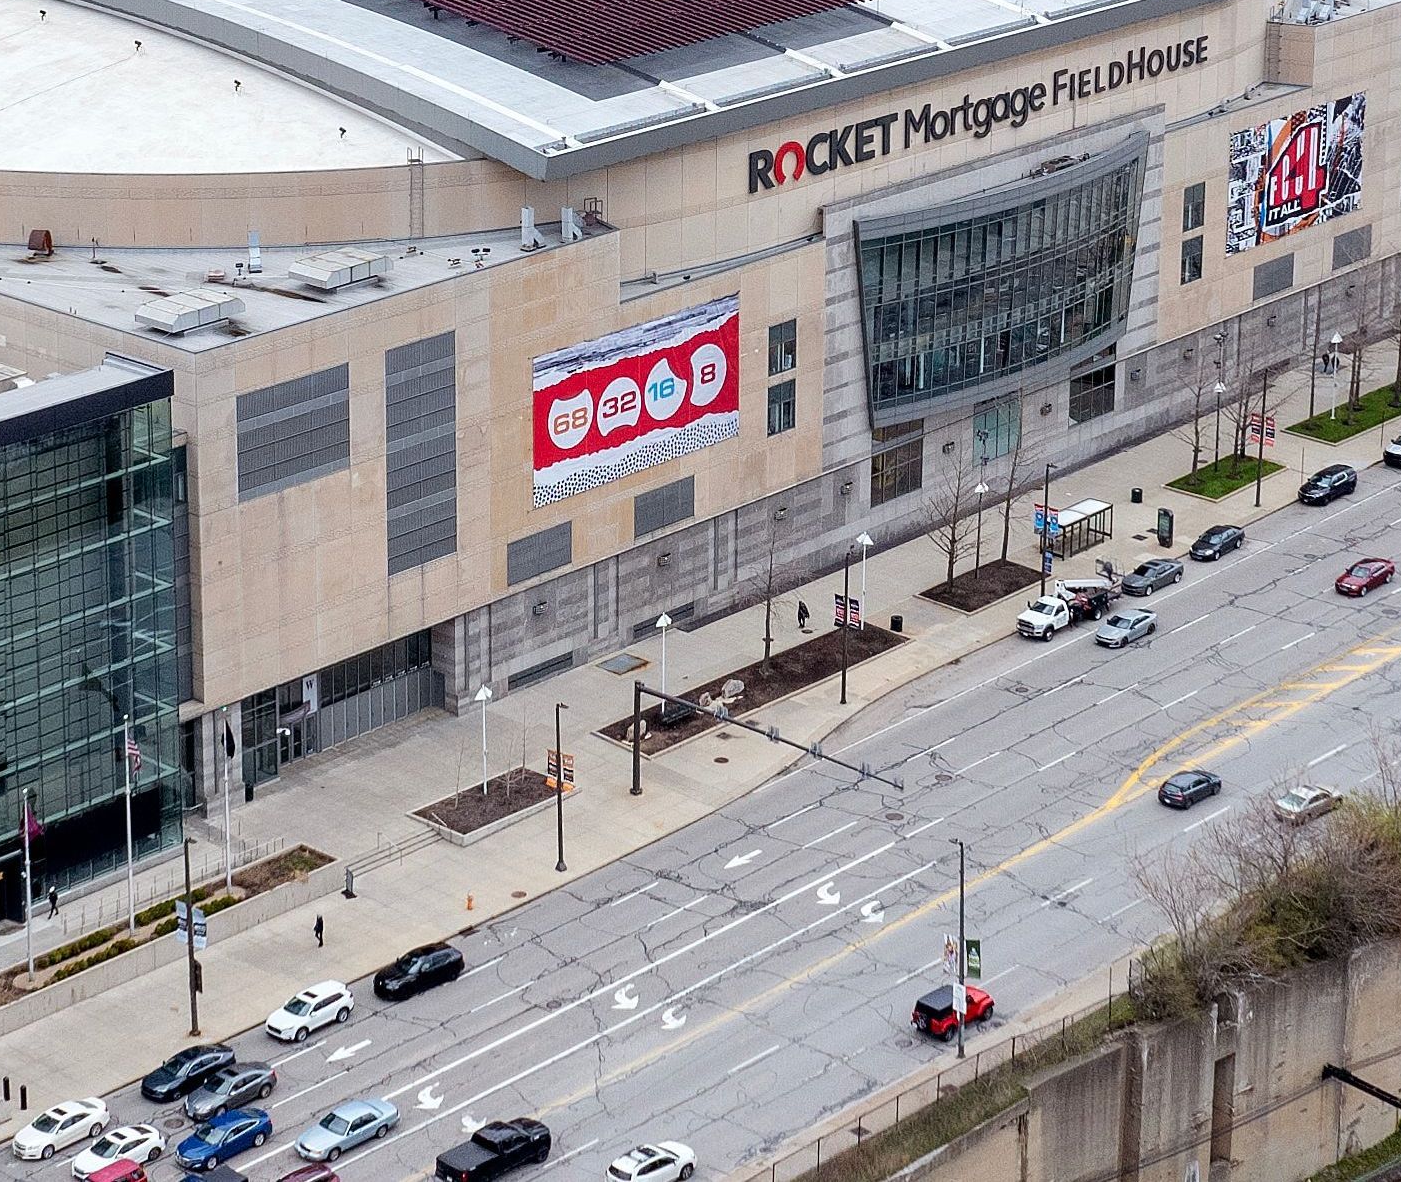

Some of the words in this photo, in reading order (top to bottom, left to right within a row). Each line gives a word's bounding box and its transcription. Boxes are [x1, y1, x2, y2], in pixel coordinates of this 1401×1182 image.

[748, 112, 899, 194] ROCKET
[904, 80, 1046, 150] Mortgage
[1268, 207, 1281, 222] IT
[1280, 200, 1302, 219] ALL
[700, 363, 716, 385] 8
[647, 377, 676, 402] 16
[602, 390, 638, 419] 32
[553, 406, 589, 436] 68
